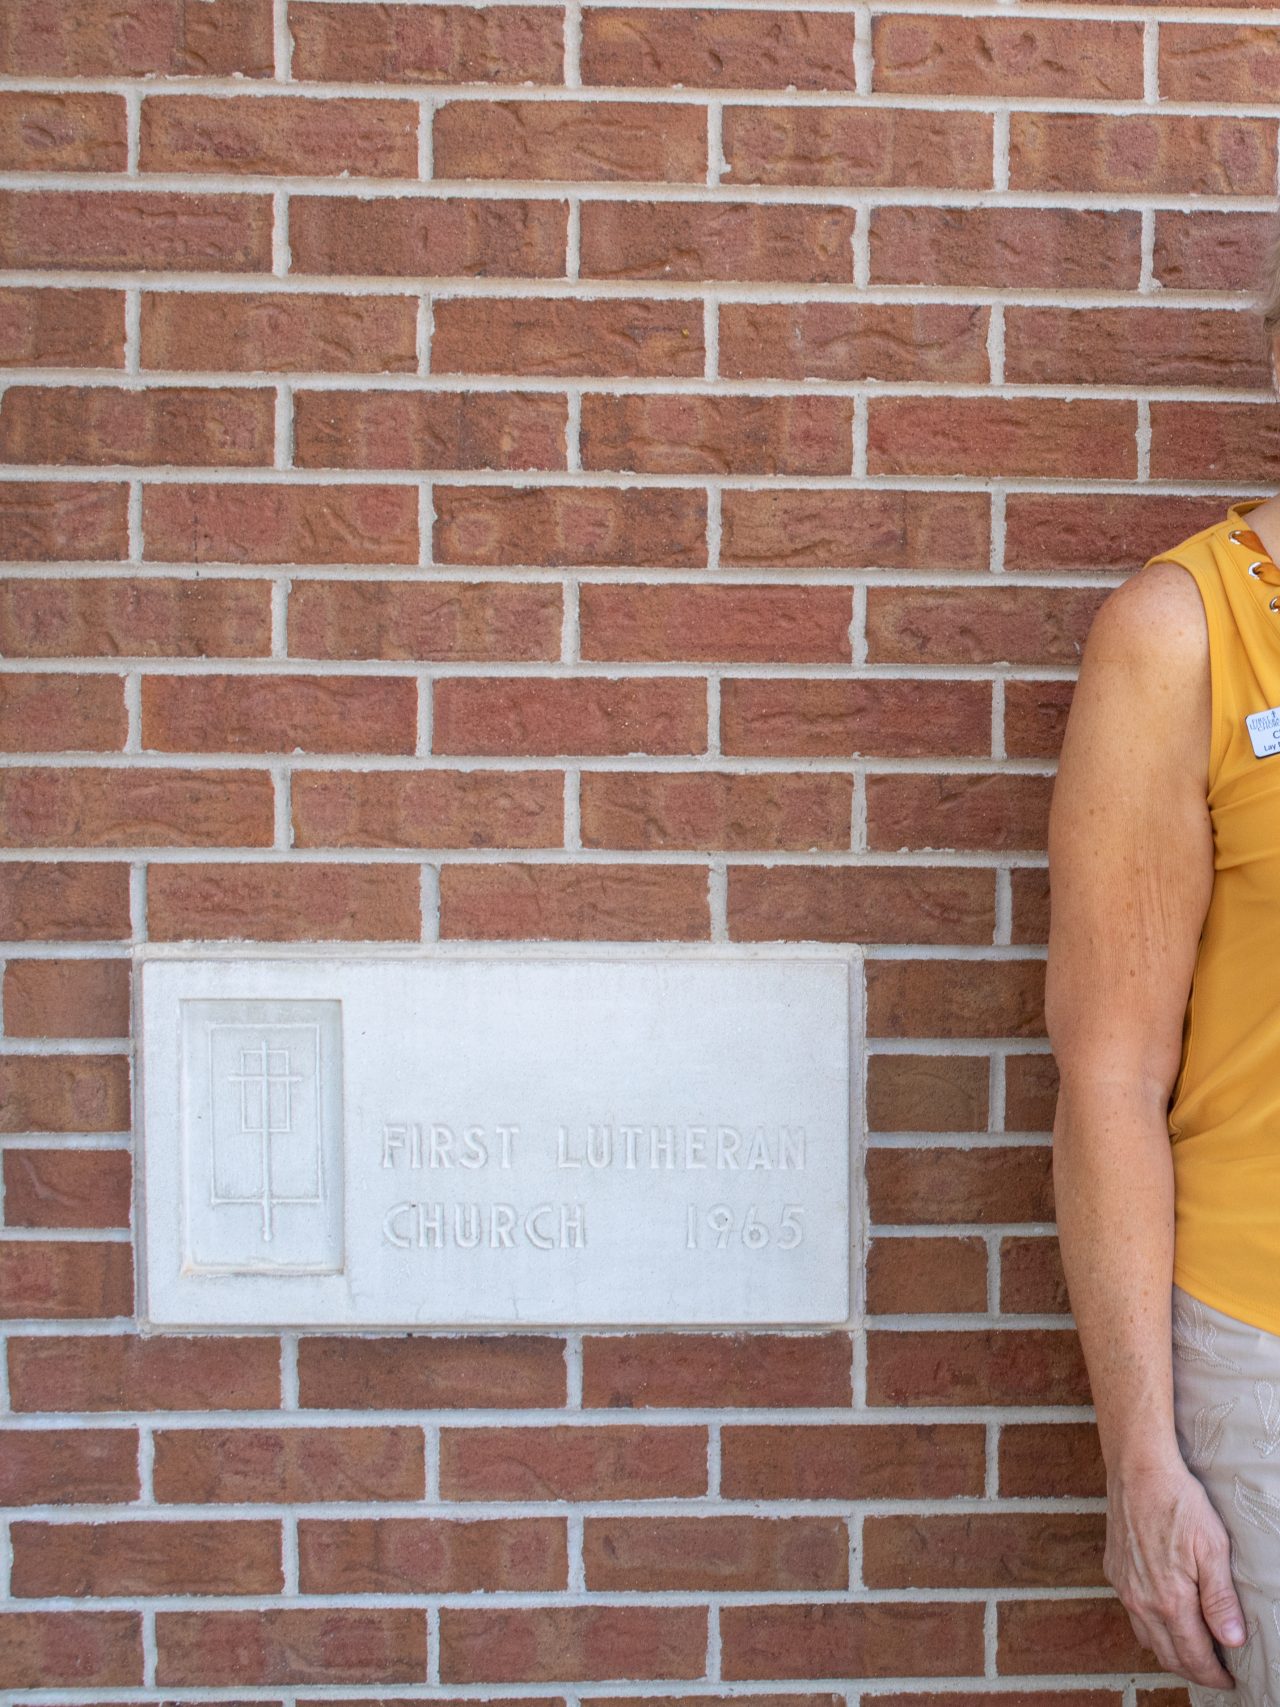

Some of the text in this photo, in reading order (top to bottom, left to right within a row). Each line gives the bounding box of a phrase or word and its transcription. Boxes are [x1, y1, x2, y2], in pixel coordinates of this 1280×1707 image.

[1264, 743, 1277, 752] Lay
[382, 1123, 806, 1170] FIRST LUTHERAN
[382, 1201, 806, 1250] CHURCH 1965
